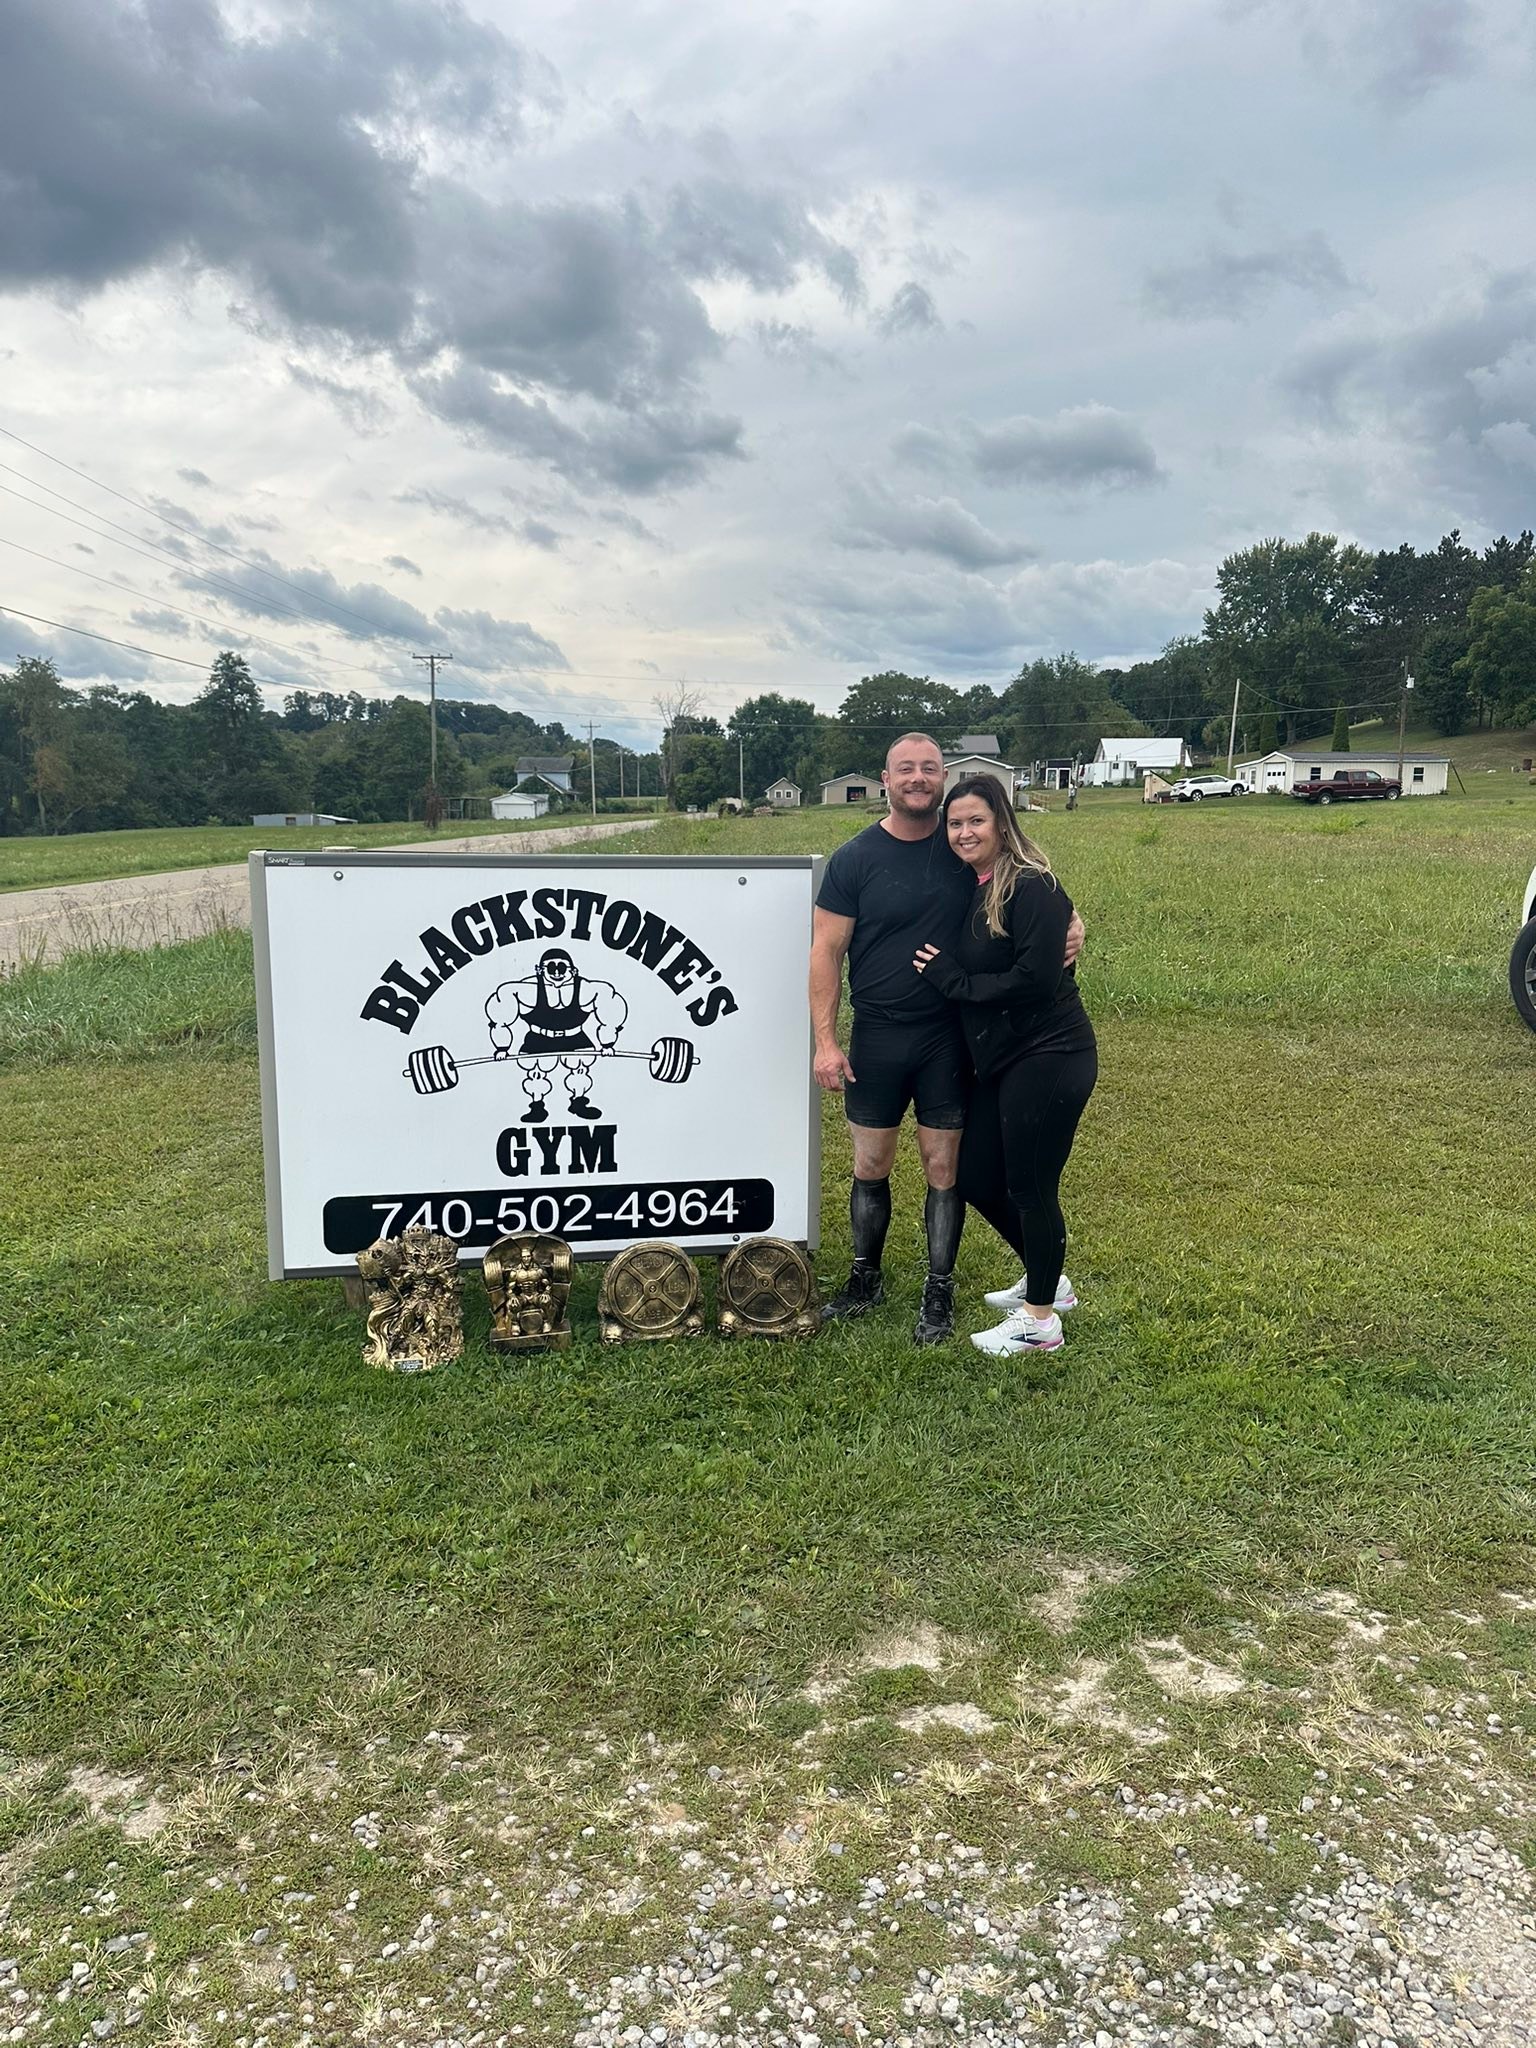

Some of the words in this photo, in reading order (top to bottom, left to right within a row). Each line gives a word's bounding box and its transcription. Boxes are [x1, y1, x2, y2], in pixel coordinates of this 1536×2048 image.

[268, 856, 290, 864] SMART
[360, 888, 738, 1035] BLACKSTONE'S
[496, 1125, 617, 1177] GYM
[372, 1187, 739, 1239] 740-502-4964
